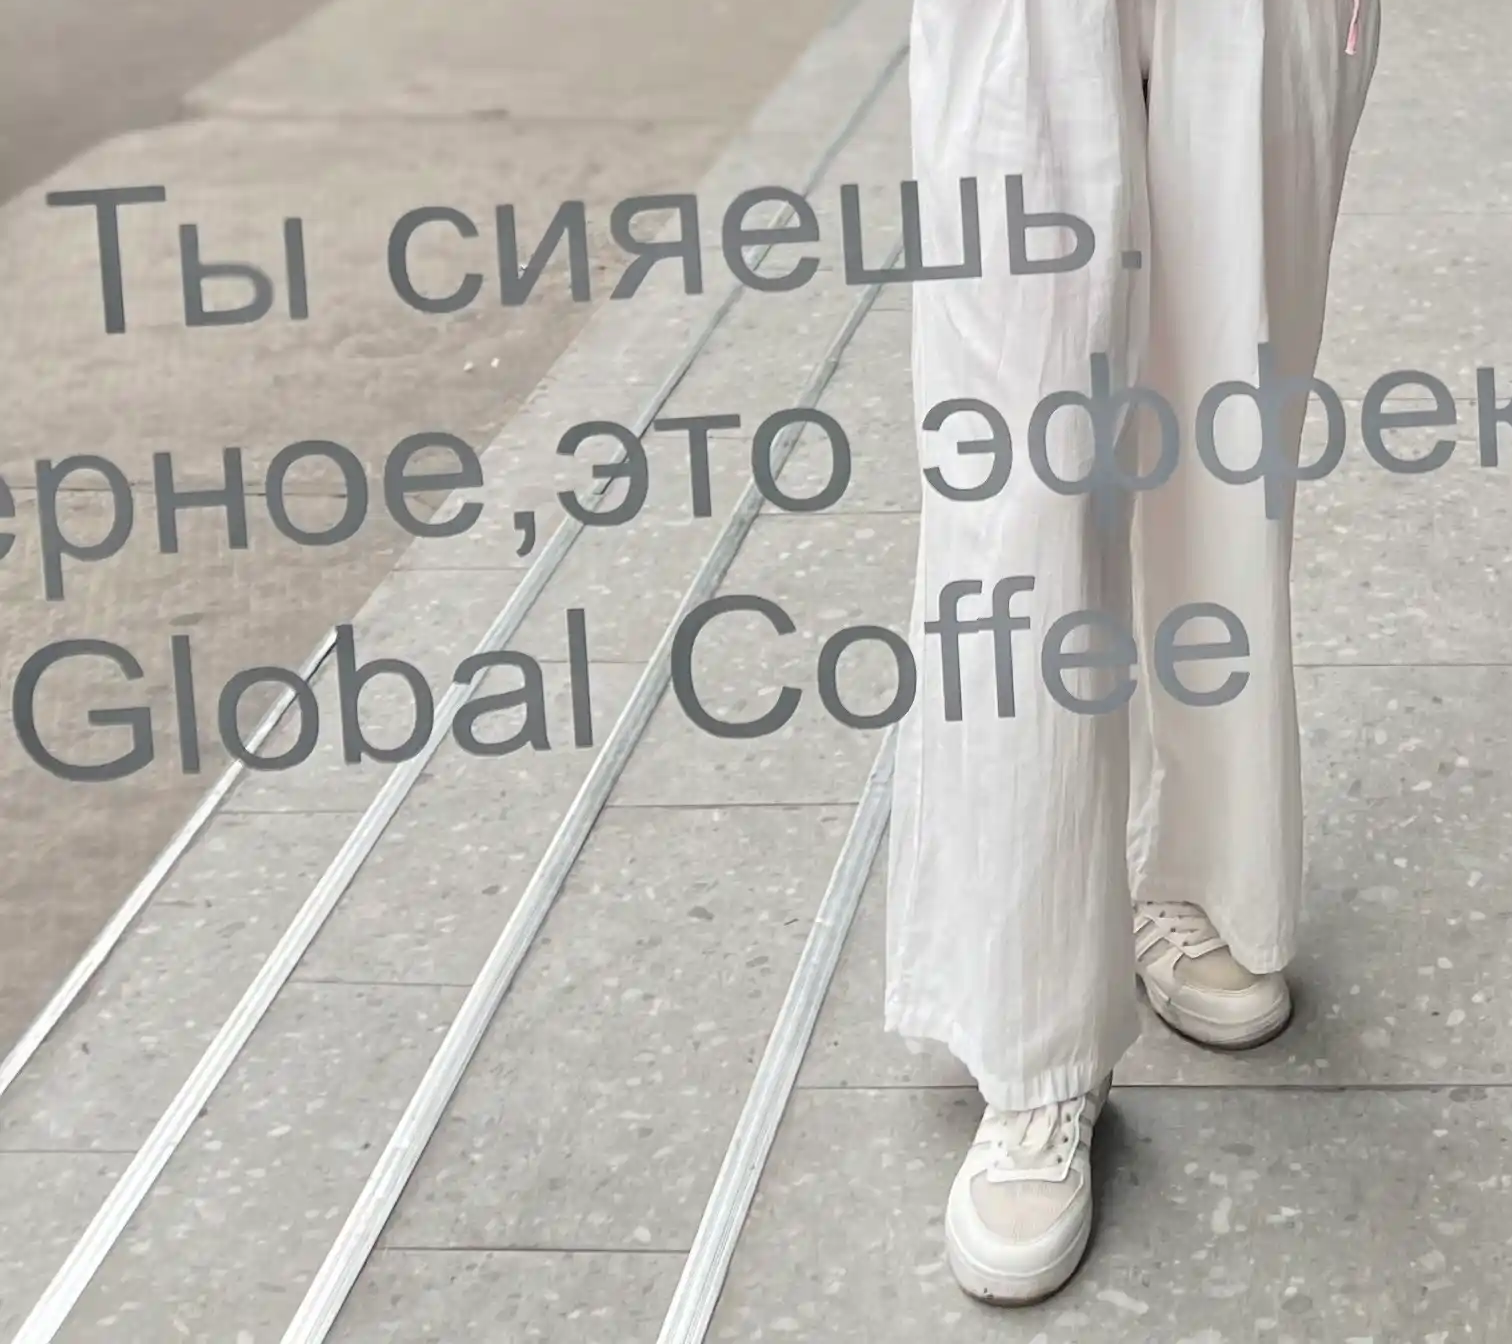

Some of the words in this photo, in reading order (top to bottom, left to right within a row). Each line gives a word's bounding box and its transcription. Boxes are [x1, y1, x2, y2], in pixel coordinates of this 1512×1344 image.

[45, 185, 309, 335] Ты
[387, 174, 1143, 314] сияешь.
[0, 407, 852, 602] рное,это
[12, 608, 595, 783] Global
[670, 575, 1251, 739] Coffee
